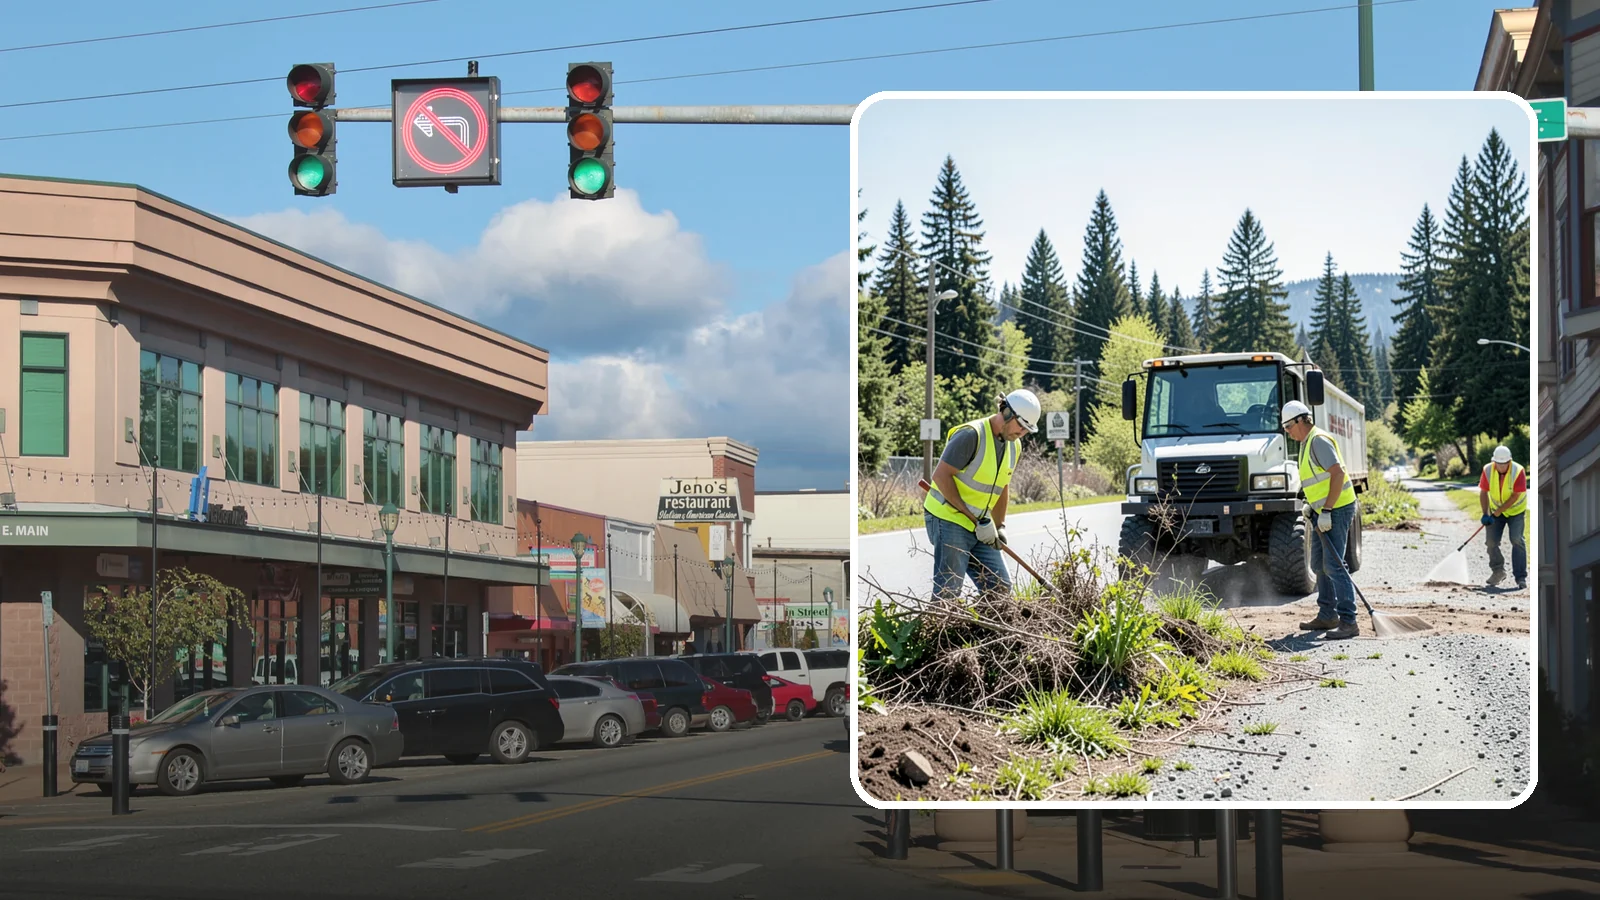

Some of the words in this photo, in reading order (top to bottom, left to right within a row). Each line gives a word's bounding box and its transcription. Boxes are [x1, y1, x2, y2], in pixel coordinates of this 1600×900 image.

[670, 480, 727, 494] Jeno's
[665, 496, 731, 509] restaurant
[658, 510, 681, 519] Italian
[686, 509, 714, 519] American
[715, 509, 738, 519] Cuisine
[2, 525, 13, 536] E.
[15, 525, 49, 536] MAIN
[797, 607, 829, 617] Street
[791, 619, 824, 627] lass
